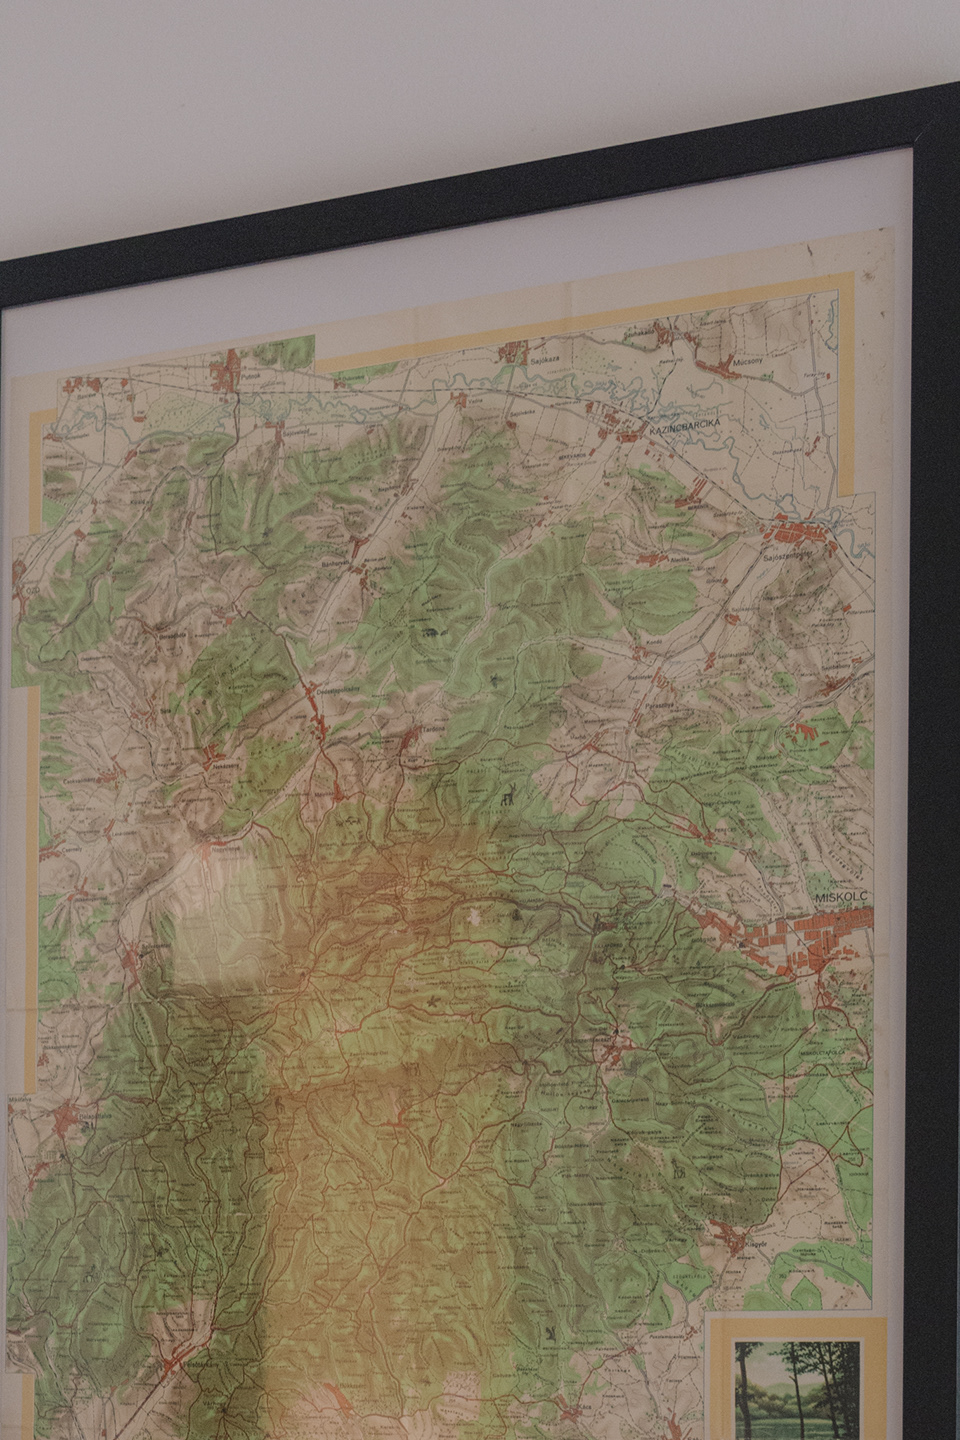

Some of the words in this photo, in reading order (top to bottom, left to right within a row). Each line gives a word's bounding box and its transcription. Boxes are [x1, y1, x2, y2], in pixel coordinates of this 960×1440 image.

[530, 356, 560, 366] Sajókaza
[649, 418, 721, 436] KAZINCBARCIKA
[763, 551, 814, 564] Sajószentpéter
[423, 725, 446, 733] Tardona
[815, 890, 869, 904] MISKOLC
